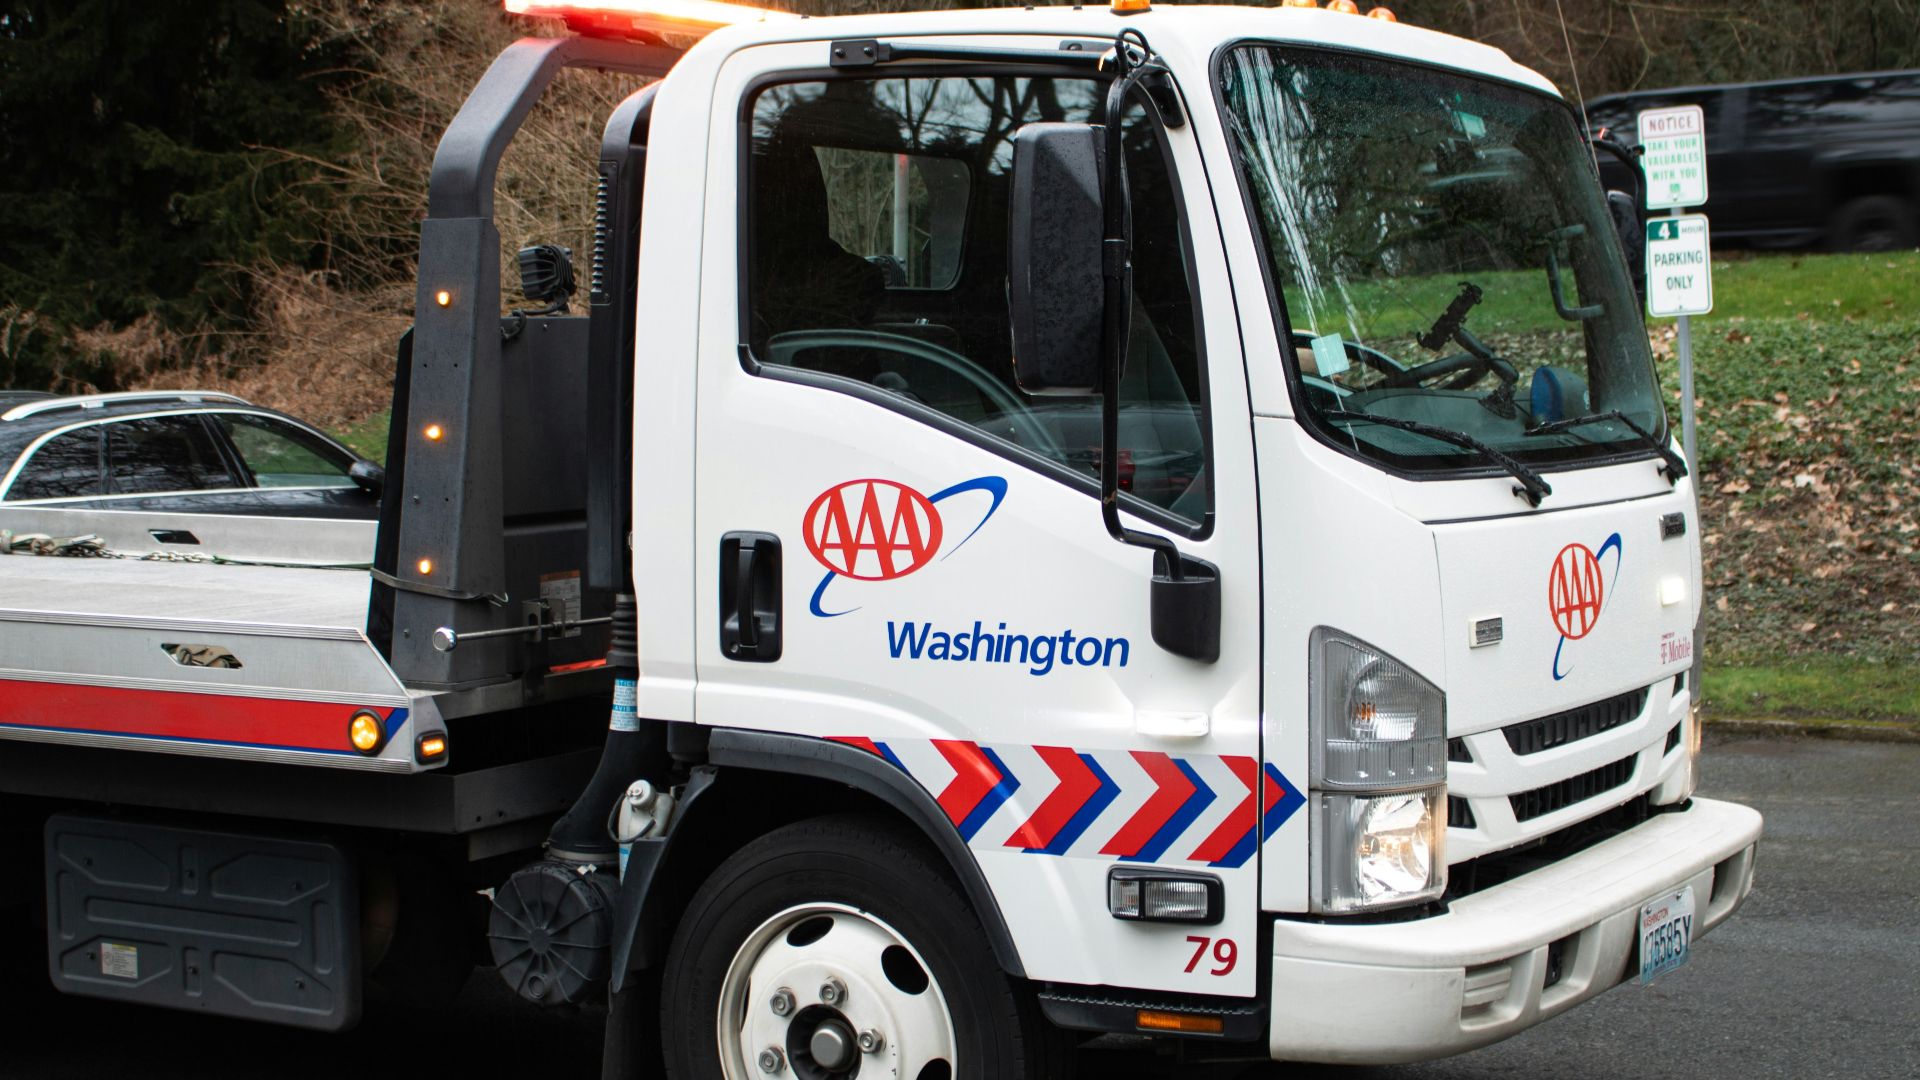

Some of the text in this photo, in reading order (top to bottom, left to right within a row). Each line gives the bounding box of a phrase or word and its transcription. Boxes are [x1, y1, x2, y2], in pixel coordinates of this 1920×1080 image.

[1649, 115, 1693, 132] NOTICE
[1648, 138, 1697, 151] TAKE YOUR
[1648, 152, 1699, 166] VALUABLES
[1652, 167, 1697, 181] WITH YOU
[1658, 222, 1670, 240] 4
[1654, 250, 1703, 267] PARKING
[1666, 275, 1694, 290] ONLY
[806, 479, 940, 581] AAA
[1550, 543, 1602, 639] AAA
[887, 621, 1130, 676] Washington
[1669, 636, 1690, 664] Mobile
[1184, 935, 1237, 976] 79
